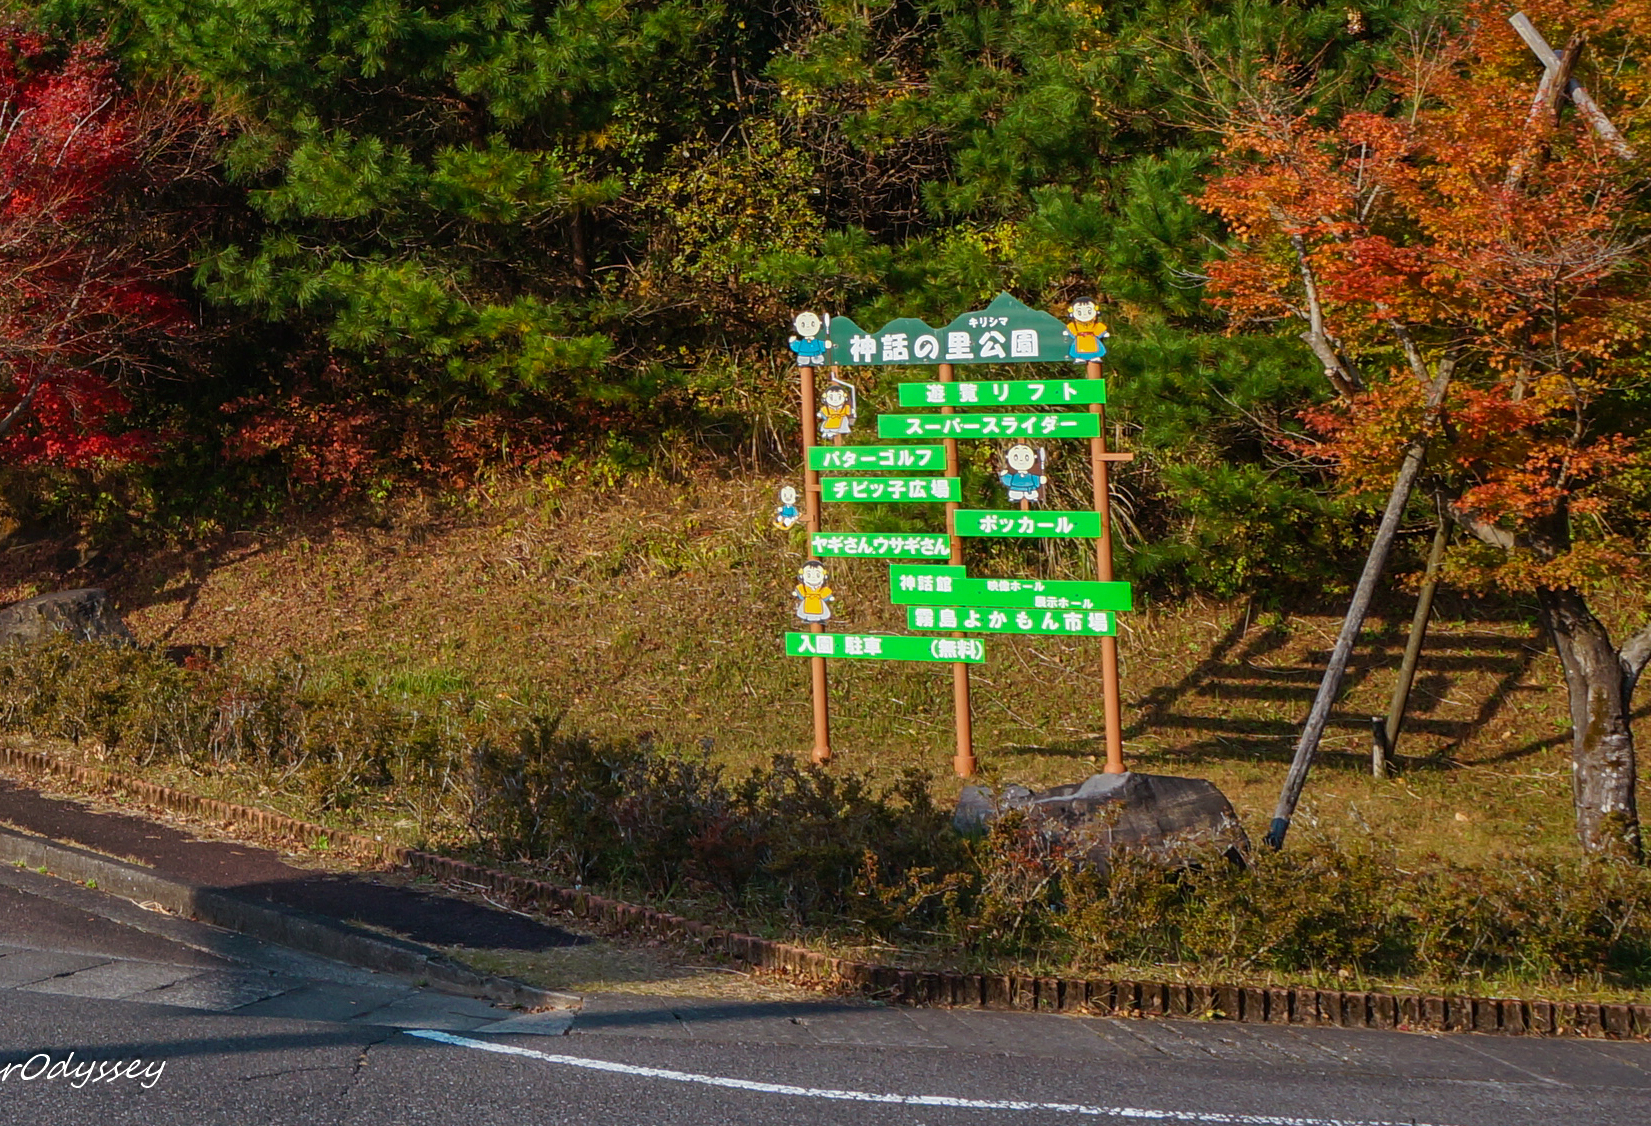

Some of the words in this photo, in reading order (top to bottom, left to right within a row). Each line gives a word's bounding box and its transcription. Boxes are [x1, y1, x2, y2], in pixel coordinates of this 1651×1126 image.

[968, 316, 1009, 329] キリシマ
[850, 329, 1039, 363] 神話の里公園
[926, 382, 1077, 403] 遊覧リフト
[906, 415, 1077, 435] スーパースライダー
[823, 449, 932, 467] パターゴルフ
[833, 479, 950, 499] チビッ子広場
[899, 574, 952, 593] 神話館
[915, 608, 1108, 632] 霧島よかもん市場
[798, 635, 834, 654] 入園
